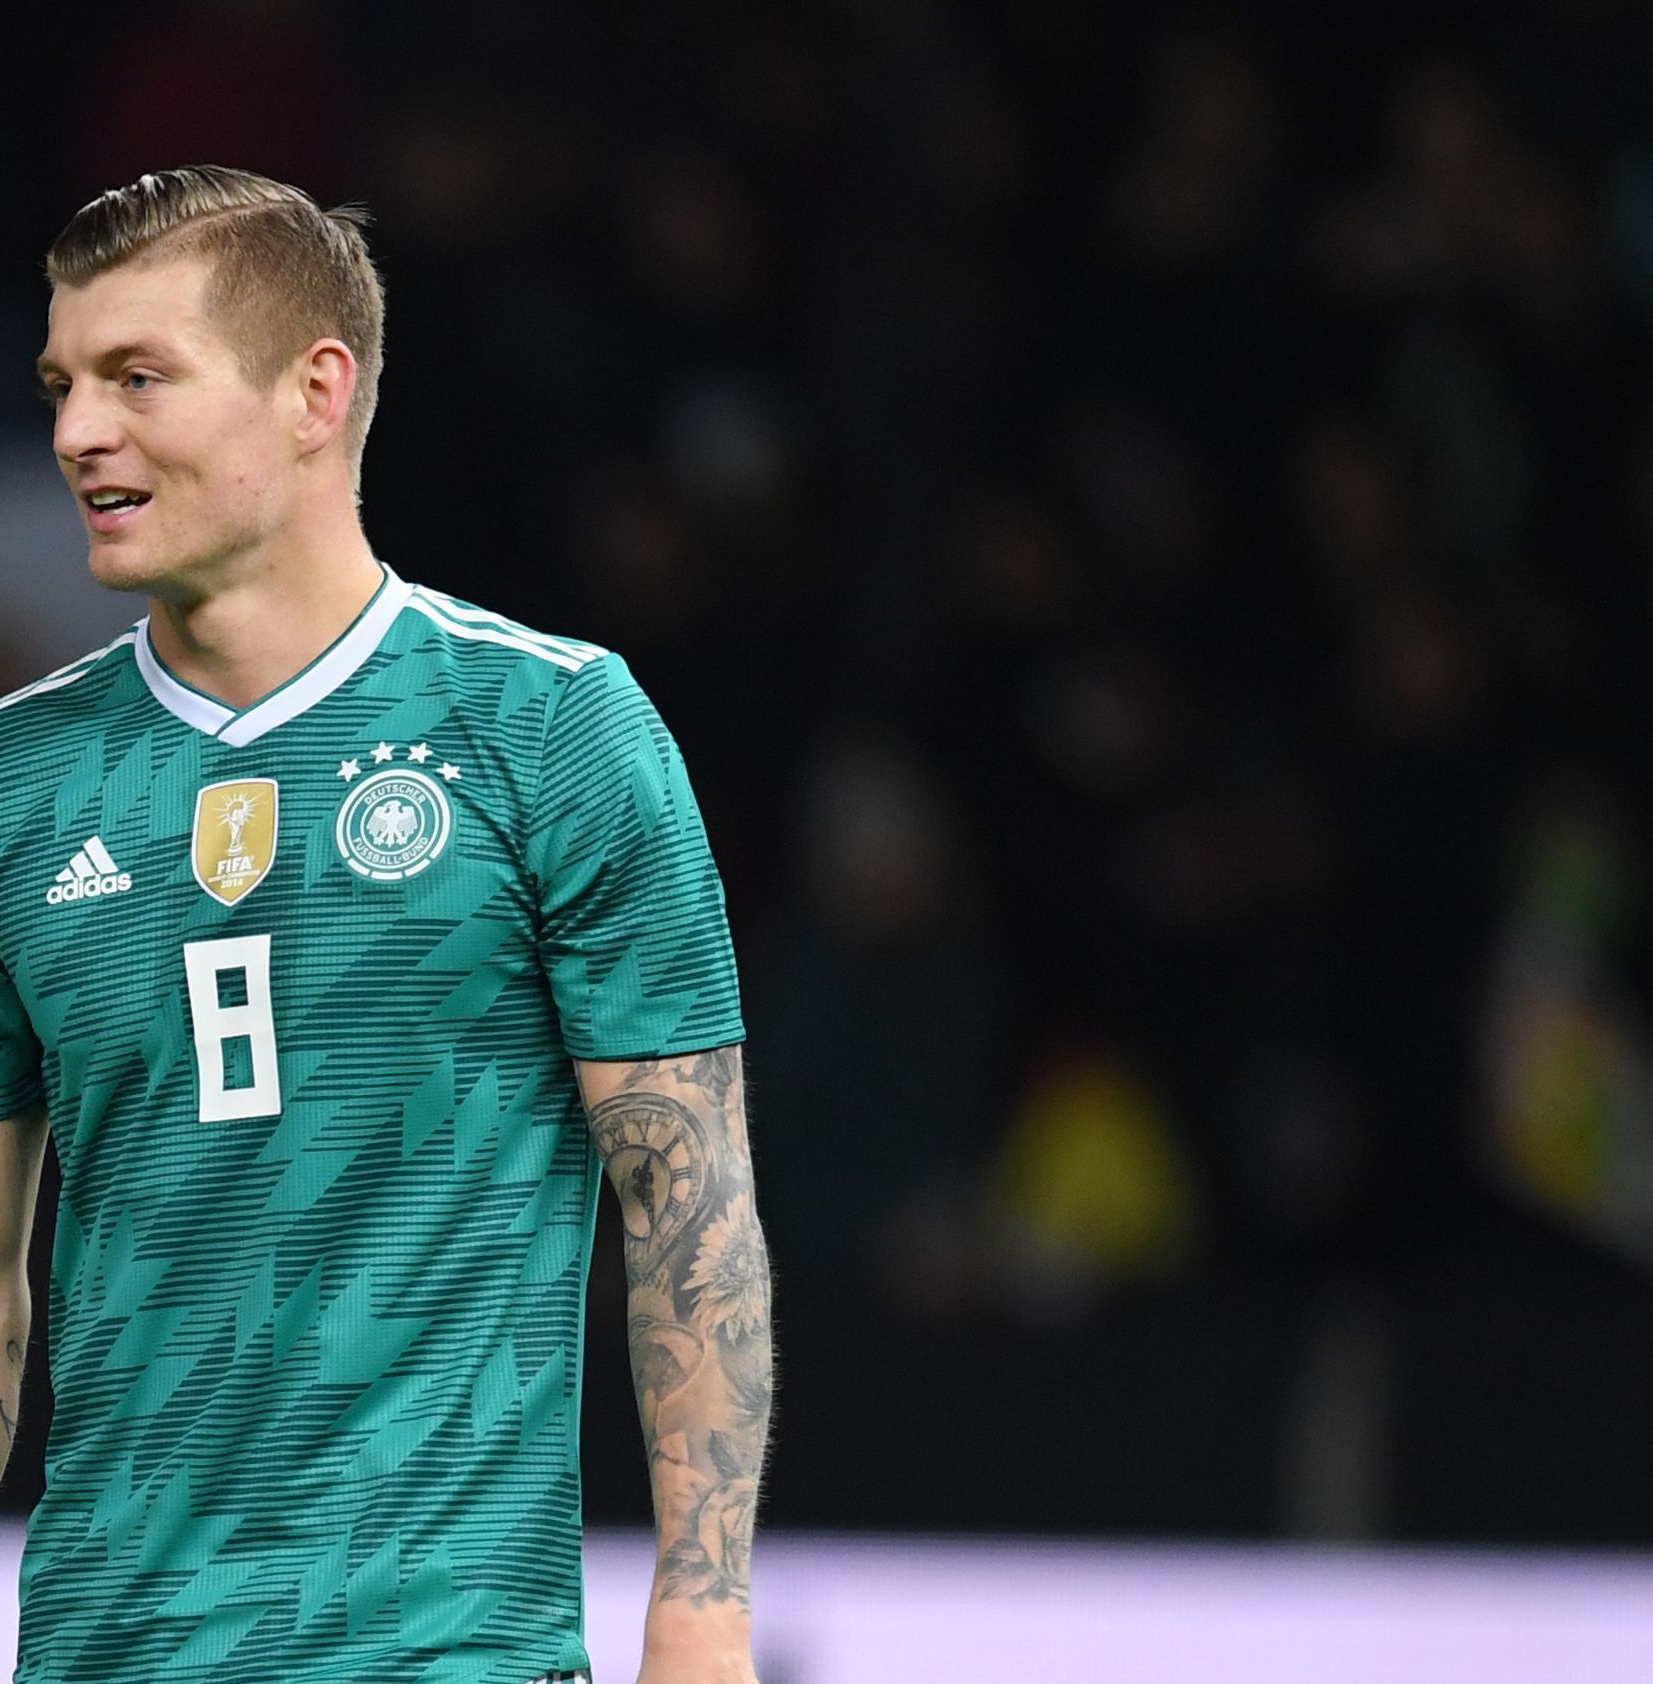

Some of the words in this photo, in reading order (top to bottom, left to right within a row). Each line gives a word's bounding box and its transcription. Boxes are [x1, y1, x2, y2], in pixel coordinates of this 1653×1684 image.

[364, 784, 426, 805] DEUTSCHER
[217, 856, 253, 875] FIFA
[46, 872, 132, 904] adidas
[183, 934, 282, 1123] 8
